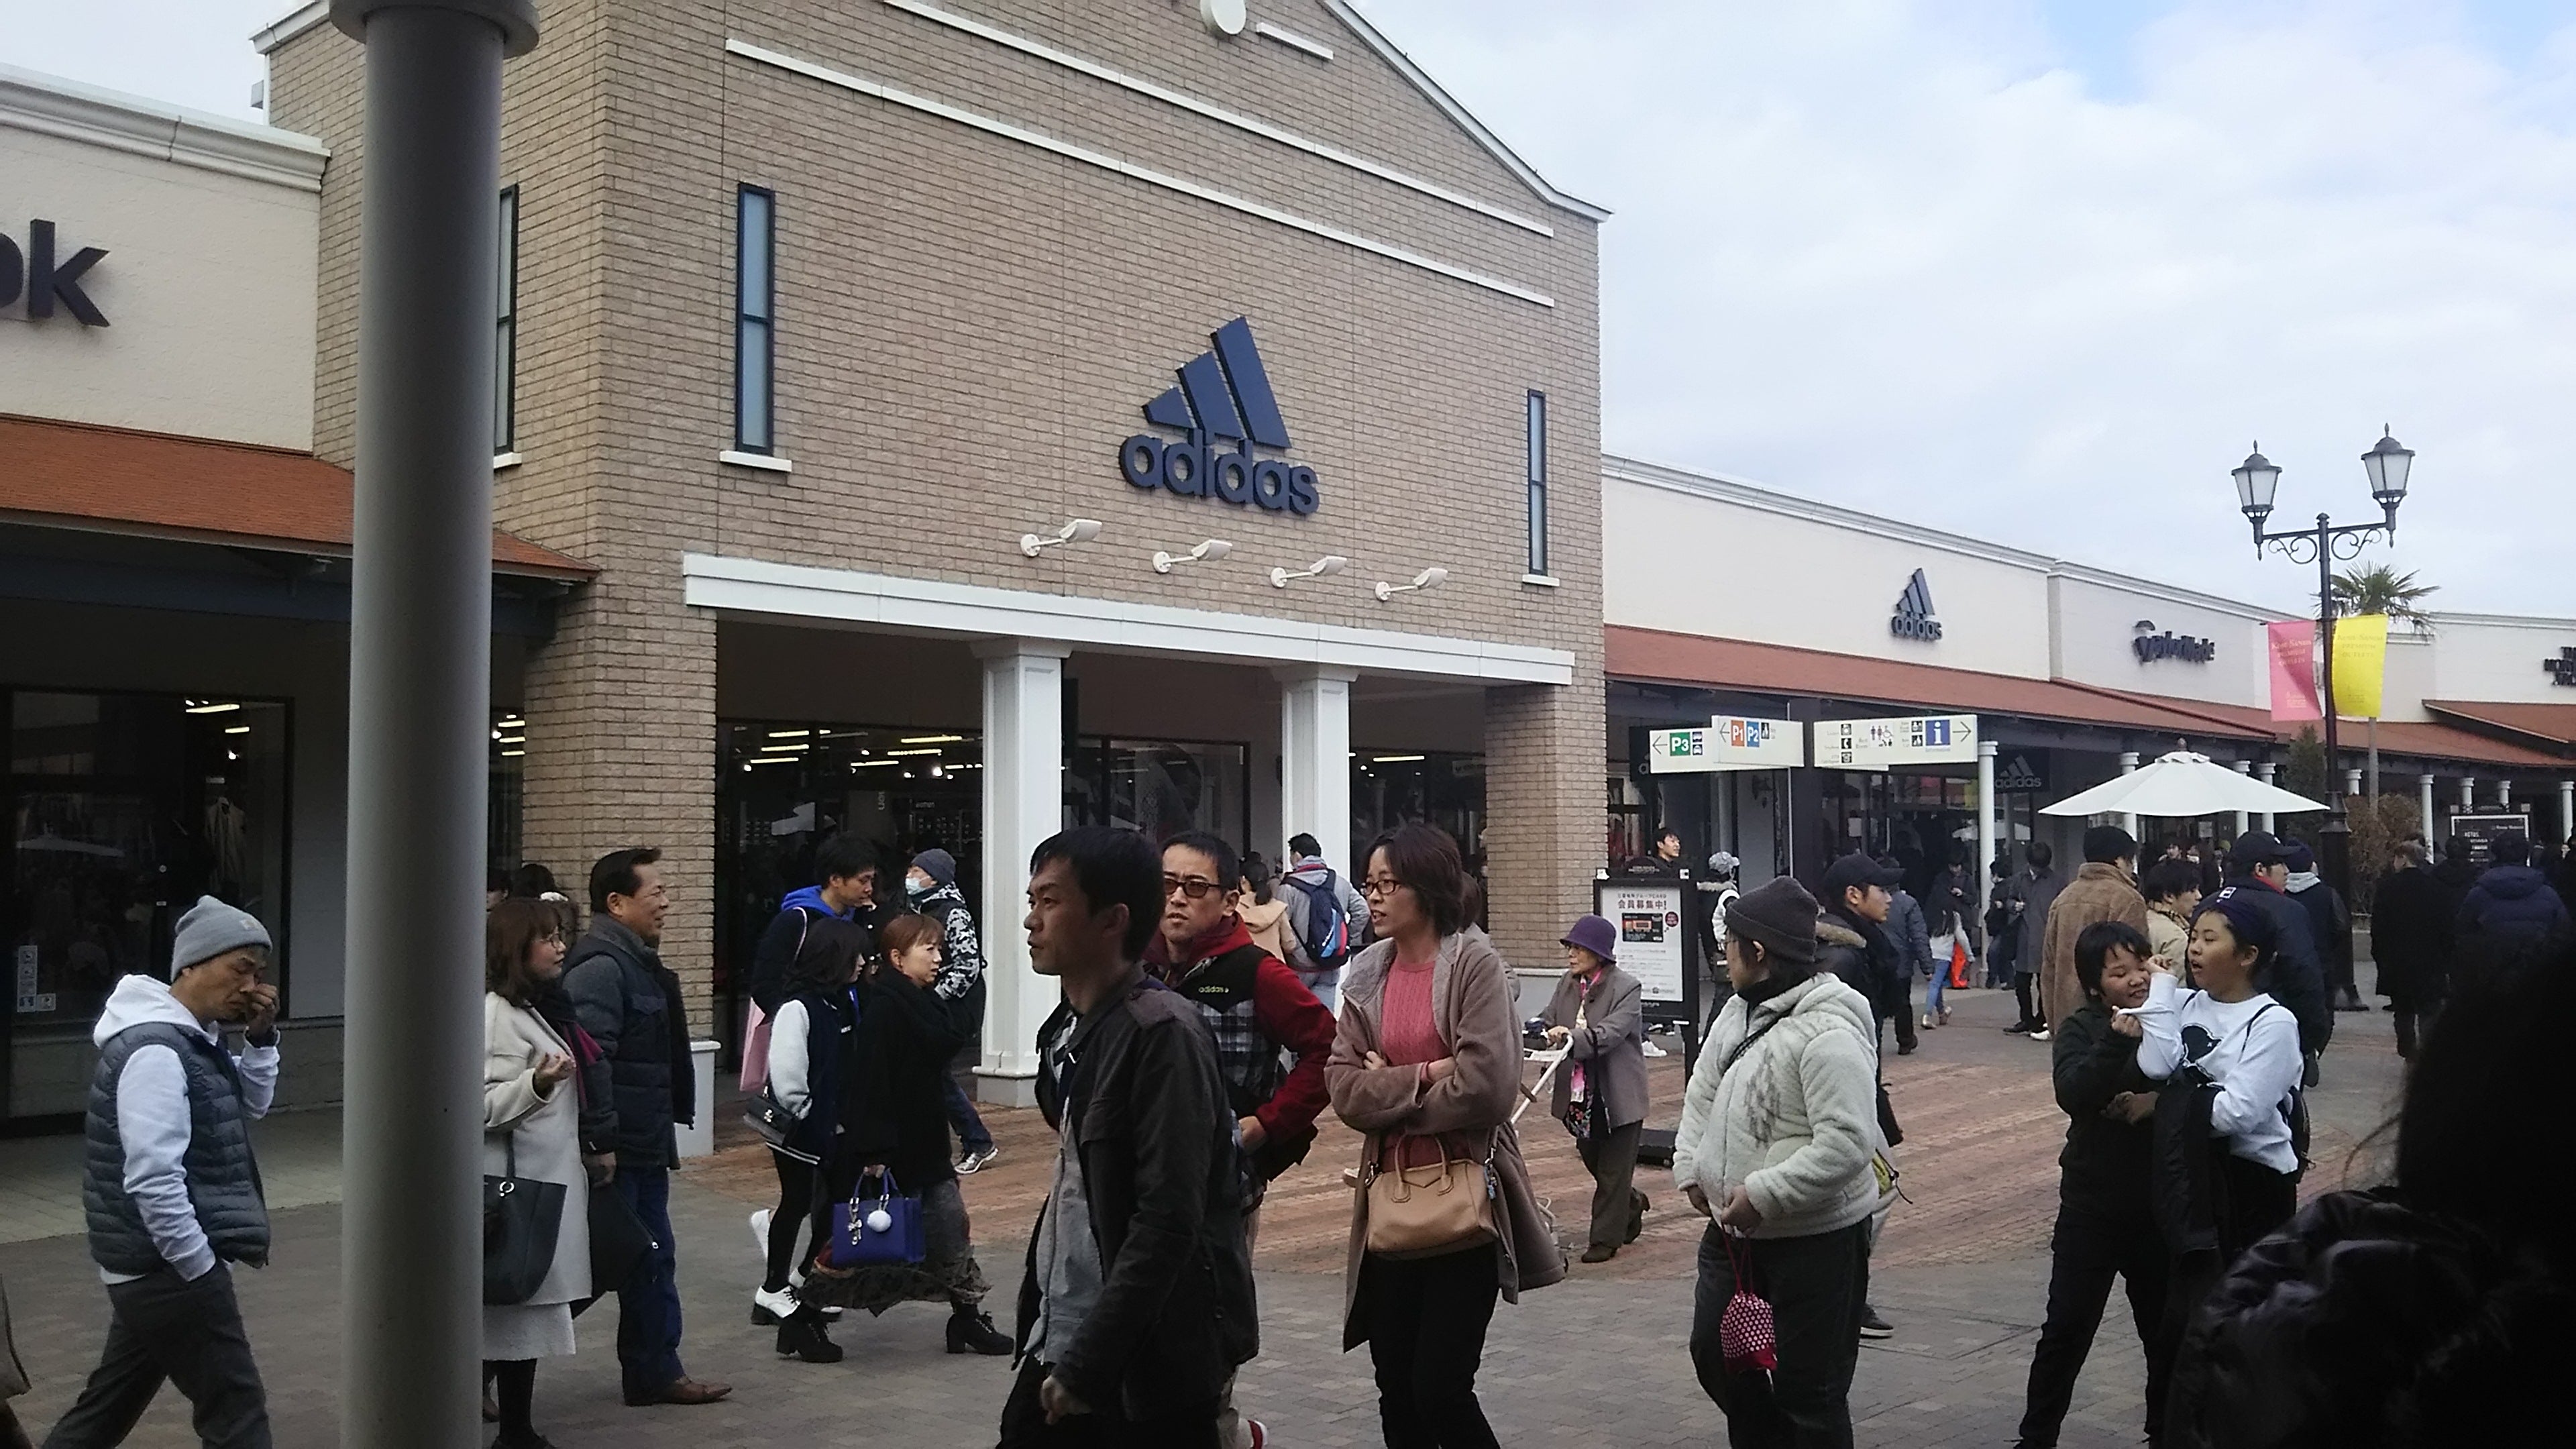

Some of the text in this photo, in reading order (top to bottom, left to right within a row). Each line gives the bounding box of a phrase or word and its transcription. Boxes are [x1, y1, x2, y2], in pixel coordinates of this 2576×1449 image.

[1119, 427, 1320, 516] adidas
[1891, 611, 1943, 641] adidas
[1732, 725, 1743, 742] P1
[1747, 728, 1759, 743] P2
[1671, 737, 1690, 752] P3
[1994, 775, 2042, 788] adidas
